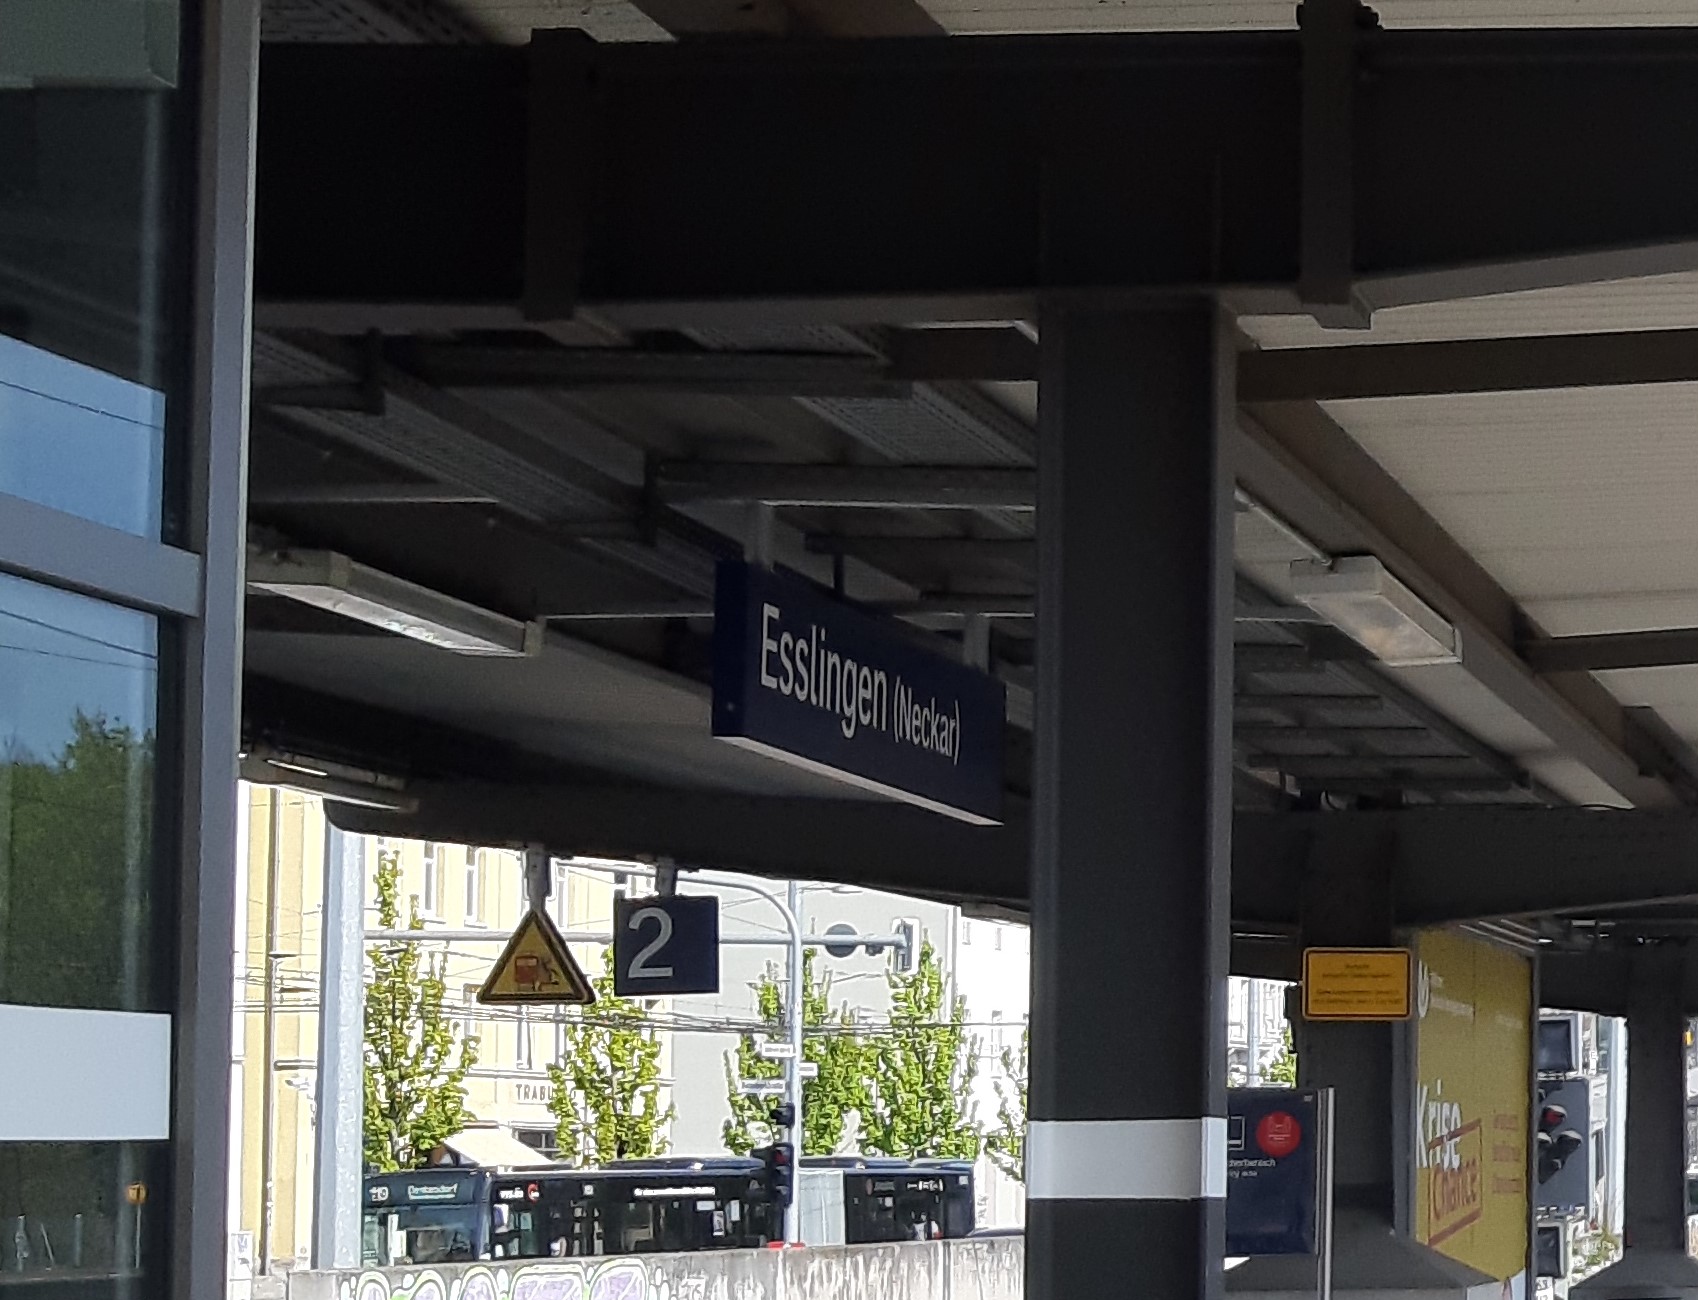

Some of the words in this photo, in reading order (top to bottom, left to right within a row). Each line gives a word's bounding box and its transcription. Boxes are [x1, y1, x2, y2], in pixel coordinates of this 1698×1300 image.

[760, 602, 887, 739] Esslingen
[893, 676, 960, 766] (Neckar)
[628, 907, 673, 978] 2
